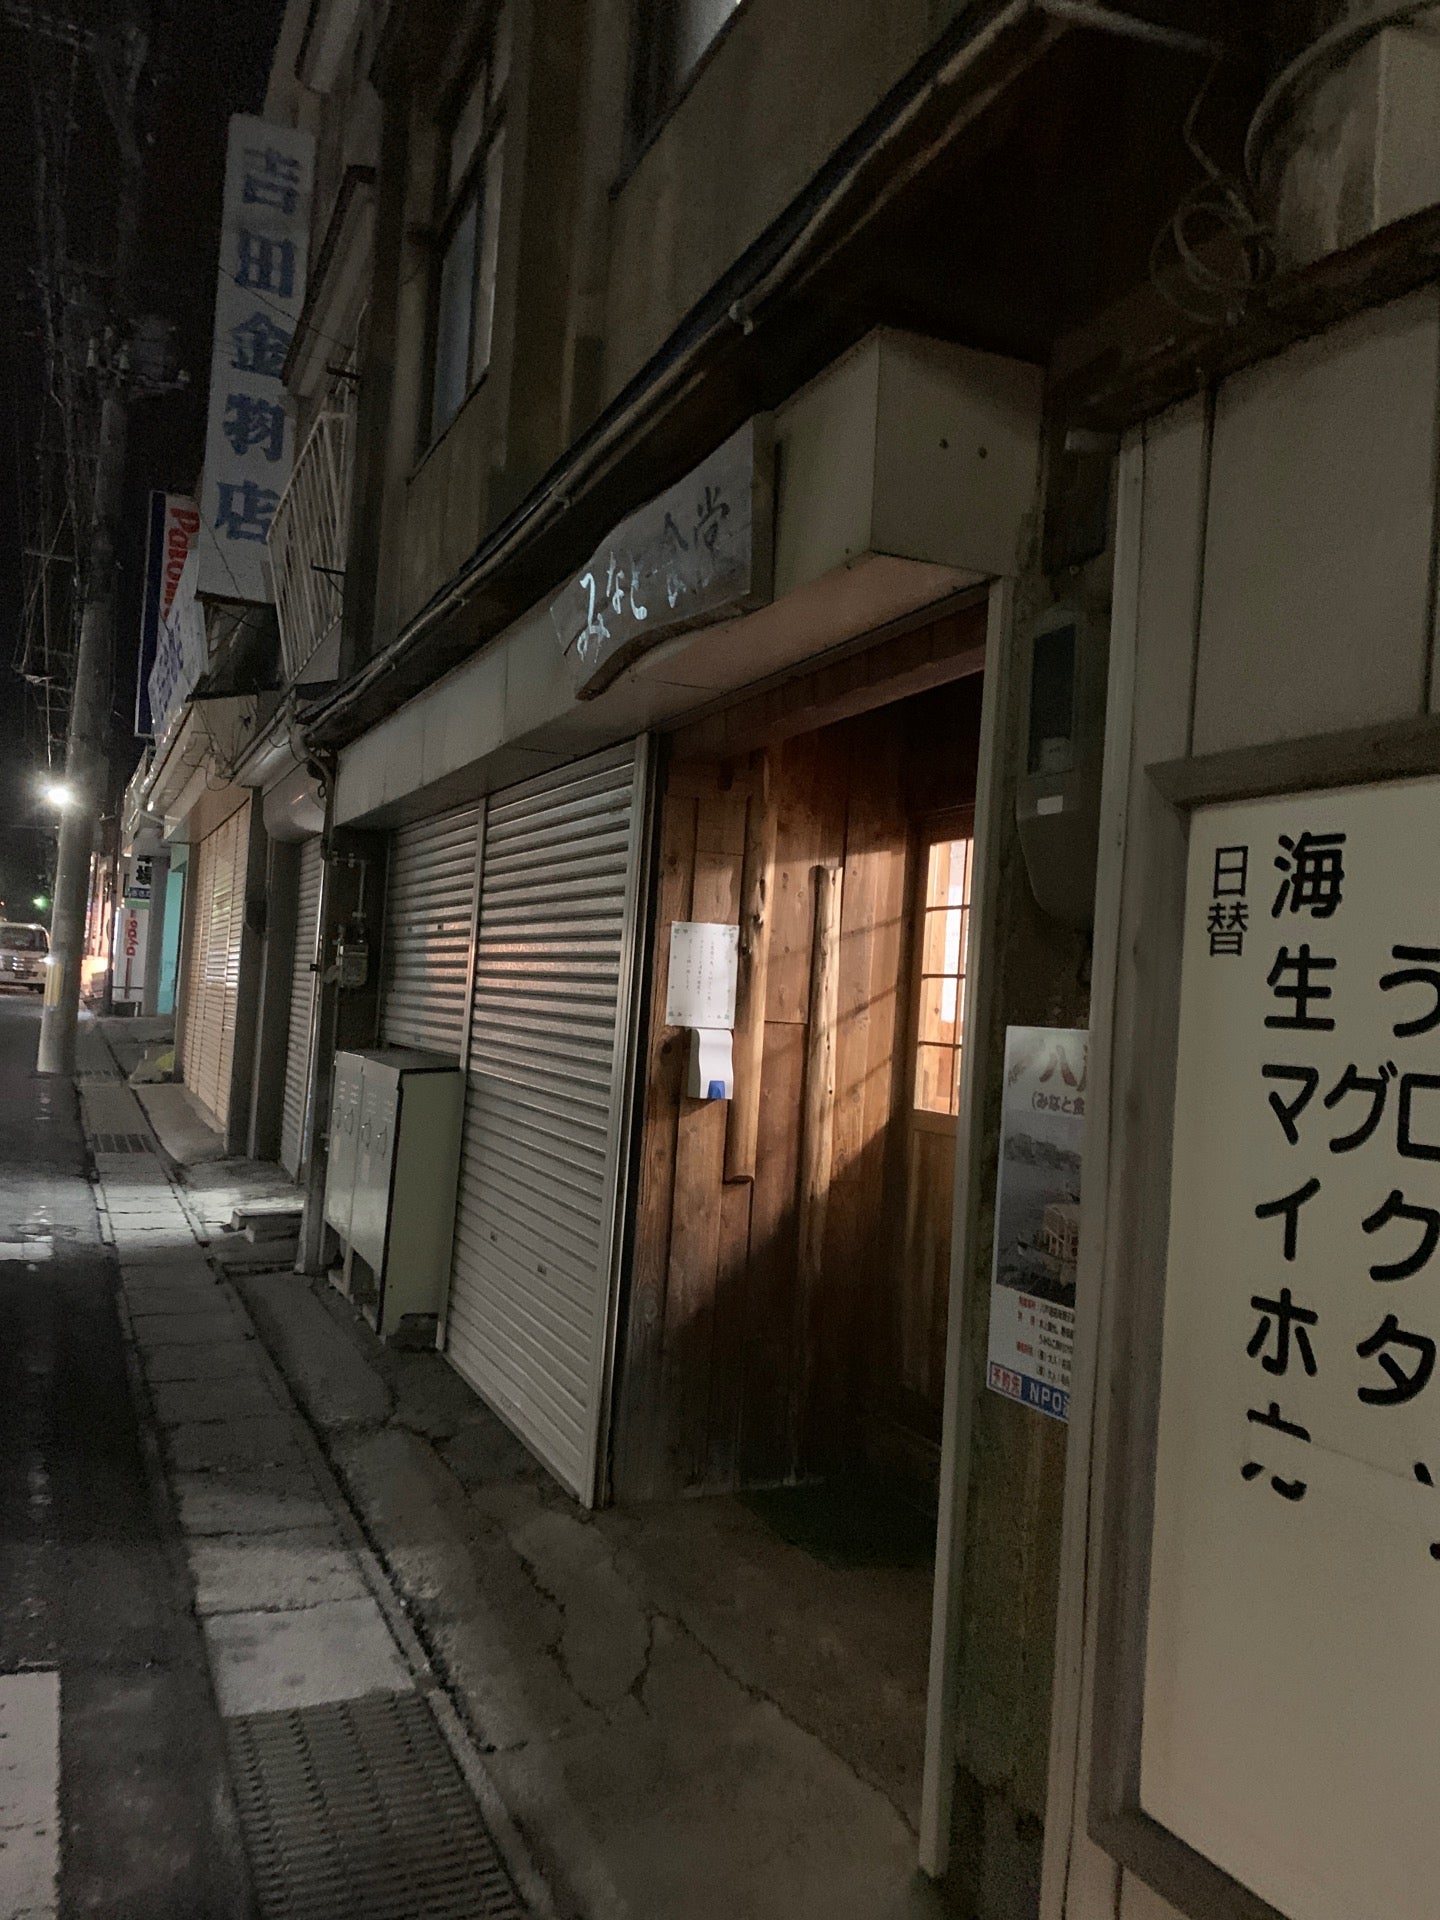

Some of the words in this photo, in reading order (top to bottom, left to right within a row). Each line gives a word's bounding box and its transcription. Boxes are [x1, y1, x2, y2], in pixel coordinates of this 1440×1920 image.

[214, 146, 302, 546] 吉田金物店
[1206, 845, 1249, 957] 日替
